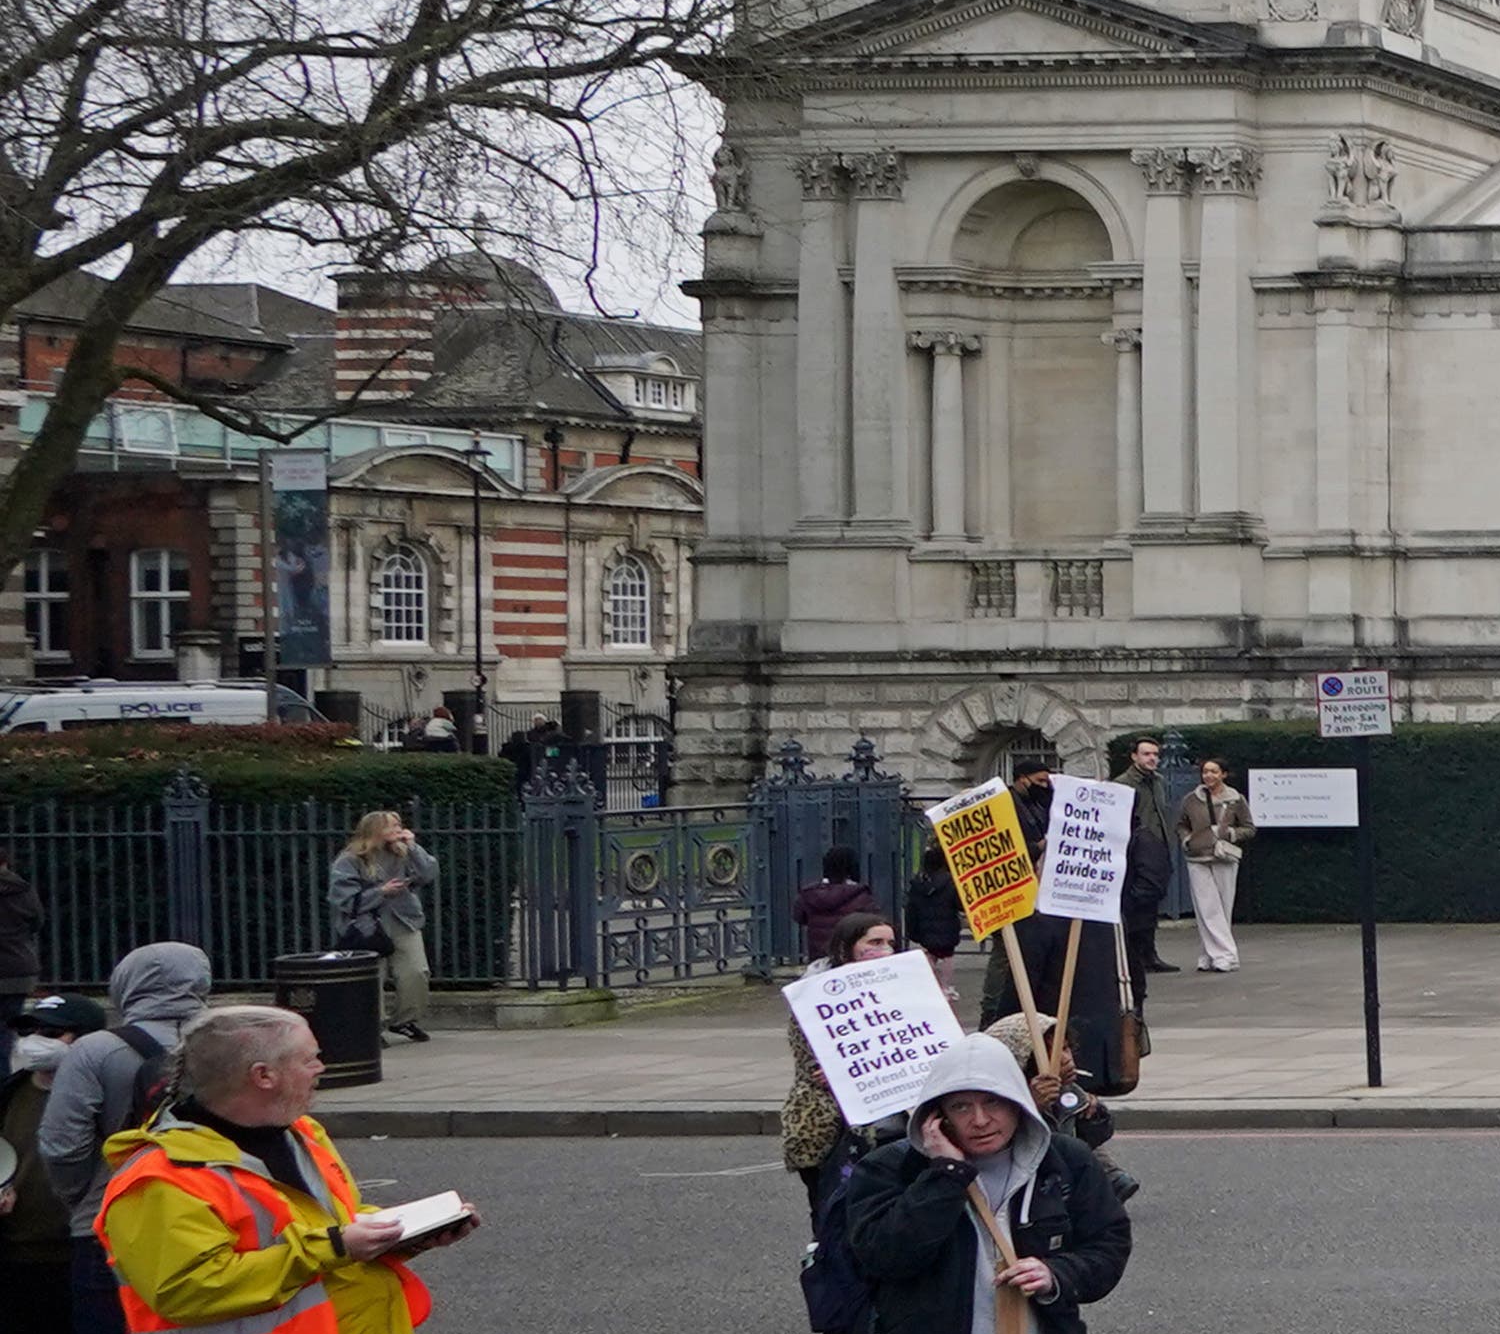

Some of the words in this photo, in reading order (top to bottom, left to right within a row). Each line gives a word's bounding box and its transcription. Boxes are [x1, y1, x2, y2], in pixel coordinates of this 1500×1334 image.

[1347, 685, 1385, 695] ROUTE
[1353, 676, 1377, 685] RED
[119, 702, 204, 715] POLICE
[941, 804, 995, 847] SMASH
[1064, 802, 1100, 824] Don't
[1061, 821, 1080, 839] let
[1084, 824, 1106, 843] the
[951, 828, 1016, 877] FASCISM
[1057, 840, 1079, 857] far
[1081, 845, 1113, 865] right
[963, 882, 974, 906] &
[972, 853, 1032, 900] RACISM
[1055, 859, 1098, 880] divide
[1100, 869, 1116, 883] us
[815, 990, 881, 1021] Don't
[825, 1018, 861, 1040] let
[864, 1007, 904, 1028] the
[836, 1038, 871, 1059] far
[878, 1020, 935, 1045] right
[847, 1046, 918, 1079] divide
[855, 1068, 908, 1093] Defend
